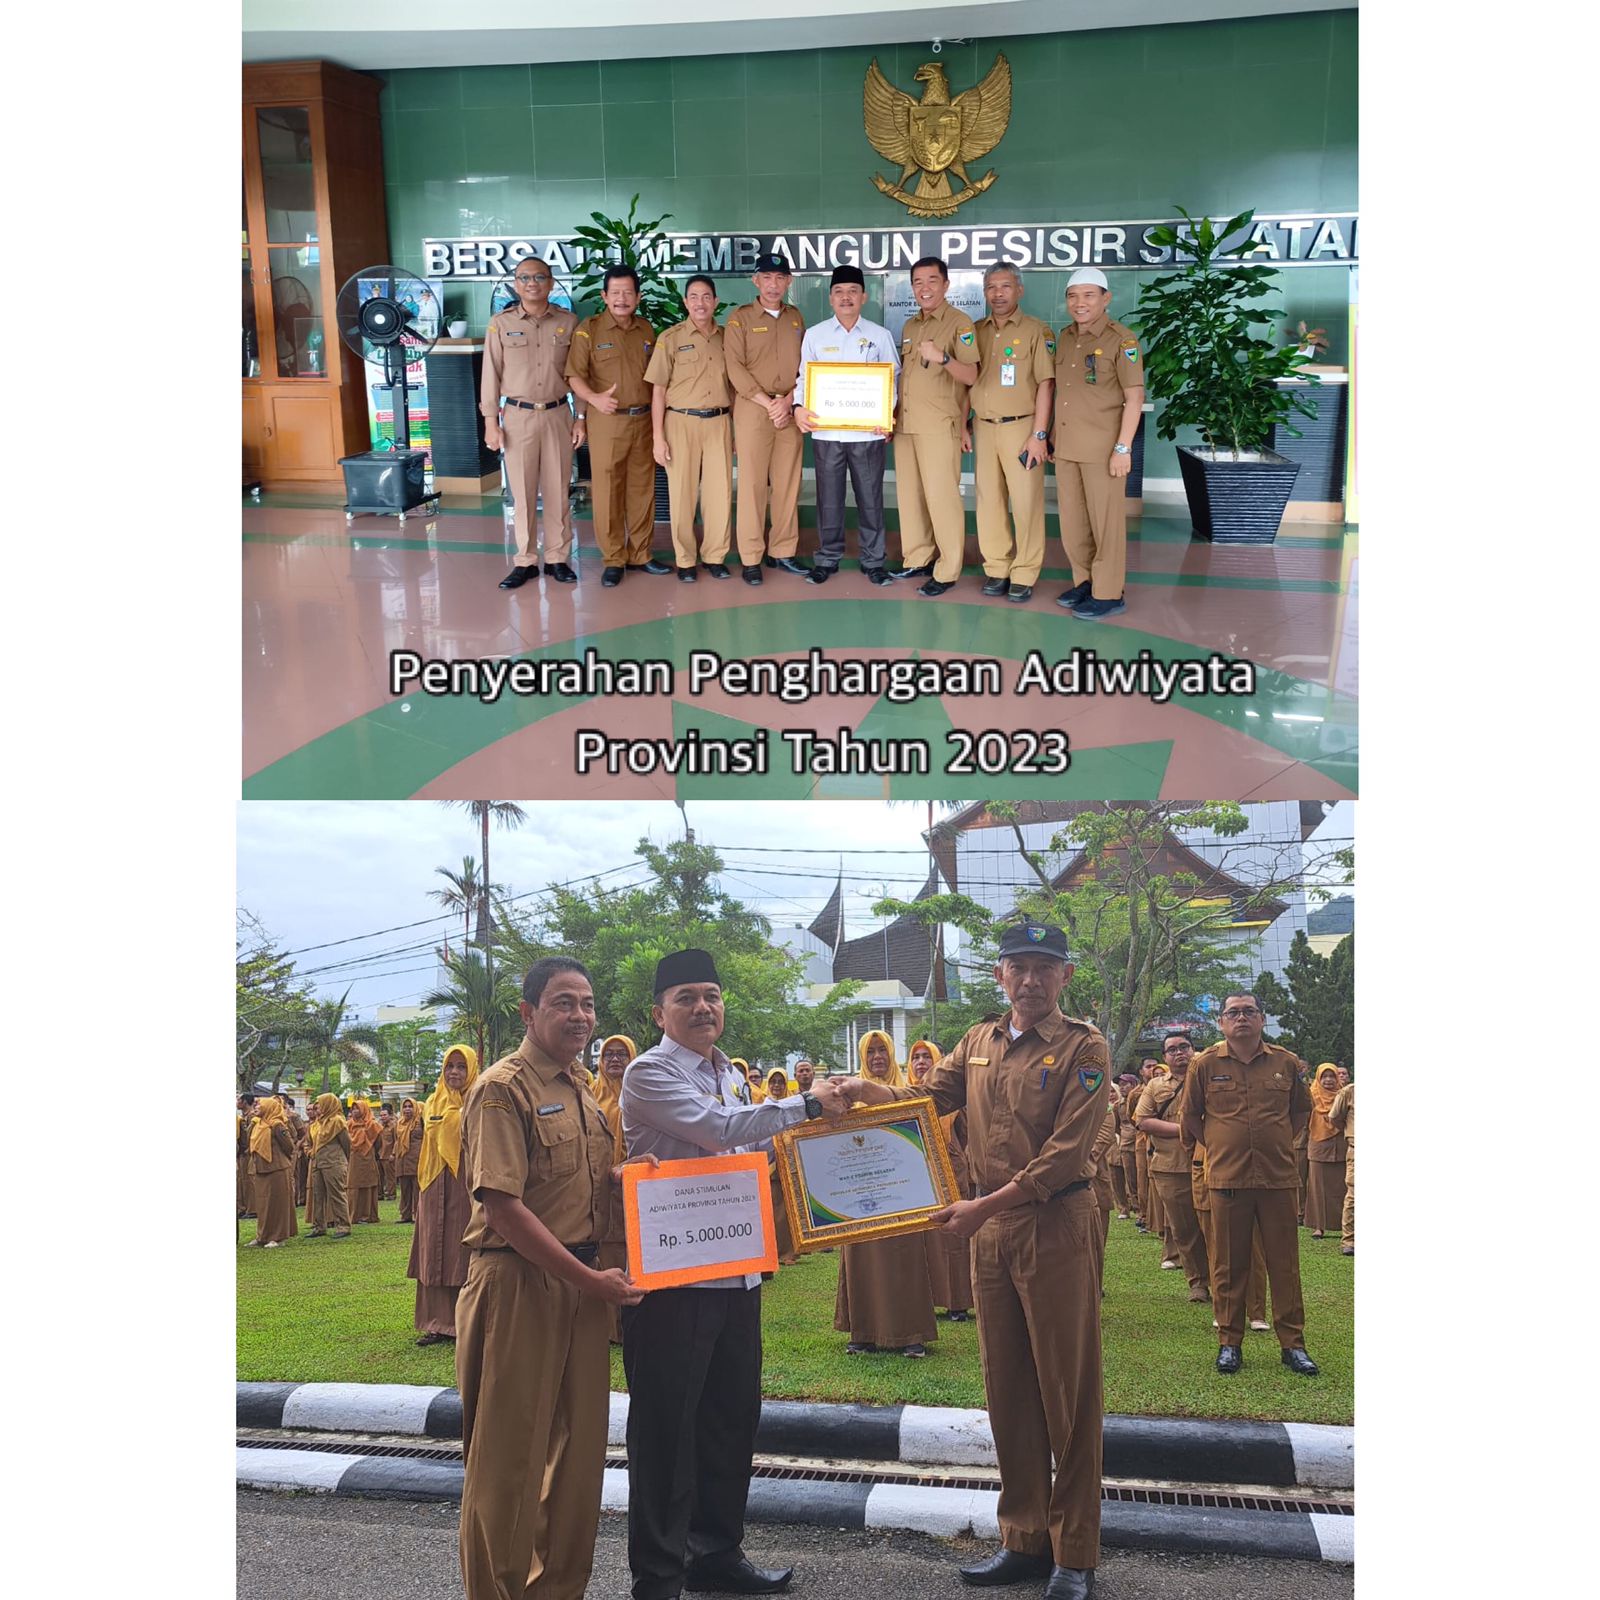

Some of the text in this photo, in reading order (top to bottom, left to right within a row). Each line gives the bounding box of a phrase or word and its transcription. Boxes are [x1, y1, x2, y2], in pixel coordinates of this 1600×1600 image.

[639, 233, 921, 271] MEMBANGUN
[941, 227, 1126, 267] PESISIR
[1139, 219, 1358, 264] SELATA
[674, 1183, 731, 1197] DANA STIMULAN
[649, 1204, 687, 1213] ADIWIYATA
[688, 1200, 717, 1209] PROVINSI
[718, 1196, 740, 1206] TAHUN
[659, 1222, 752, 1250] Rp. 5.000.000
